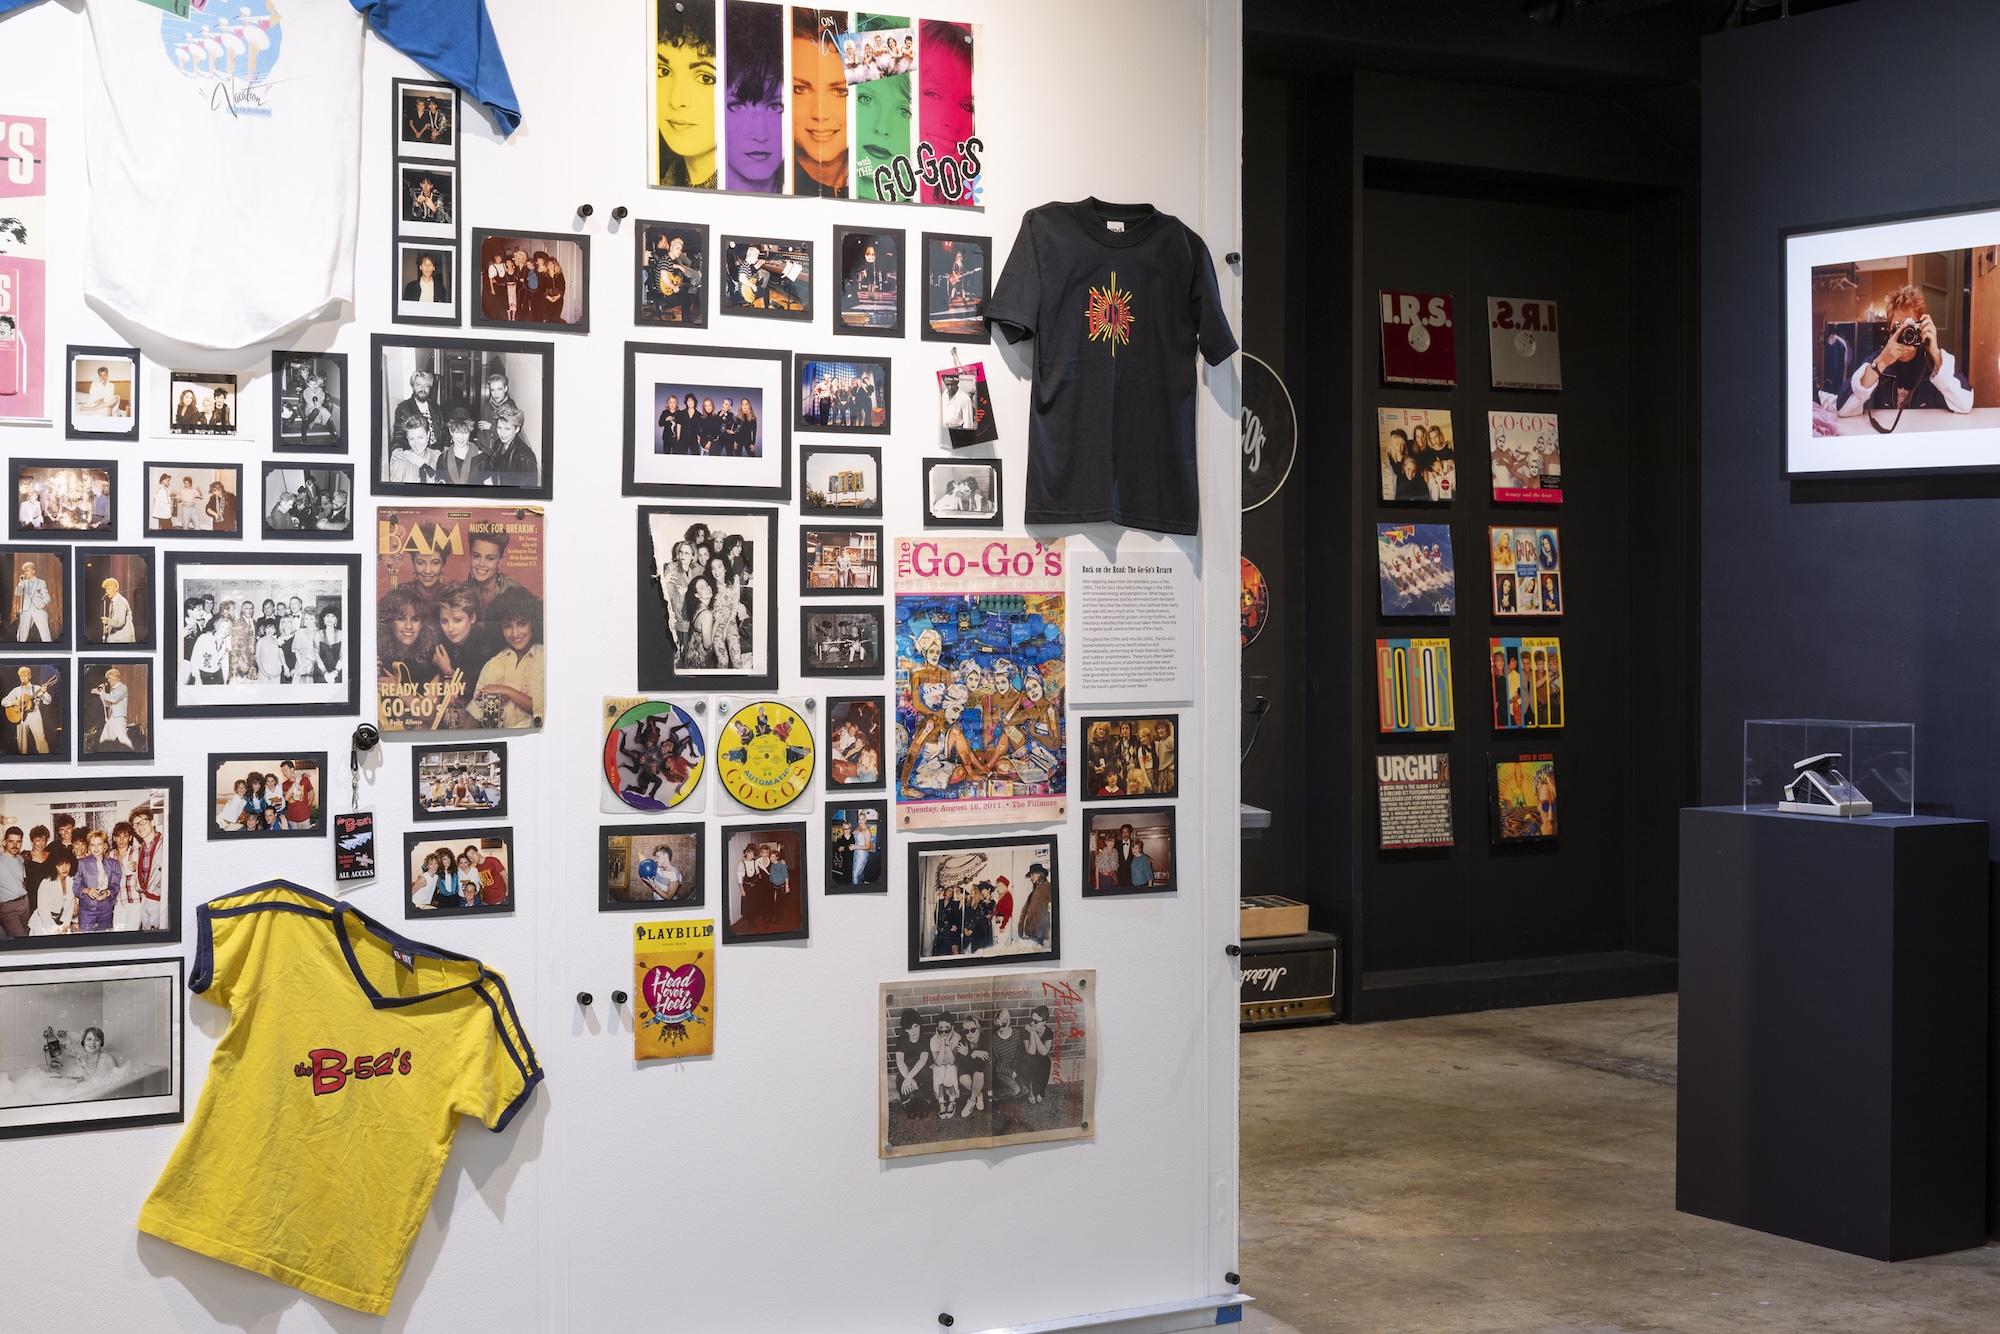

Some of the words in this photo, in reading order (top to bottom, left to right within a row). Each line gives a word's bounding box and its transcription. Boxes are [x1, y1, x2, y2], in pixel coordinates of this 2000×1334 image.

[821, 16, 834, 27] ON
[856, 156, 872, 167] with
[856, 165, 873, 178] THE
[873, 137, 984, 202] GO-GO'S
[1382, 294, 1452, 328] I.R.S.
[470, 523, 490, 534] MUSIC
[491, 523, 503, 534] FOR
[378, 520, 464, 556] BAM
[898, 542, 911, 578] The
[912, 542, 1062, 578] Go-Go's
[898, 580, 944, 590] GIRL
[960, 579, 977, 590] IN
[991, 579, 1000, 590] A
[1012, 578, 1063, 590] COMA
[381, 682, 419, 697] READY
[424, 682, 466, 696] STEADY
[1378, 754, 1438, 782] URGH!
[744, 768, 790, 785] AUTOMATIC
[906, 806, 938, 814] Tuesday,
[638, 926, 712, 940] PLAYBILL
[651, 966, 696, 998] Head
[663, 988, 690, 998] over
[923, 993, 940, 1002] Head
[655, 992, 692, 1014] Heels
[294, 1062, 314, 1077] the
